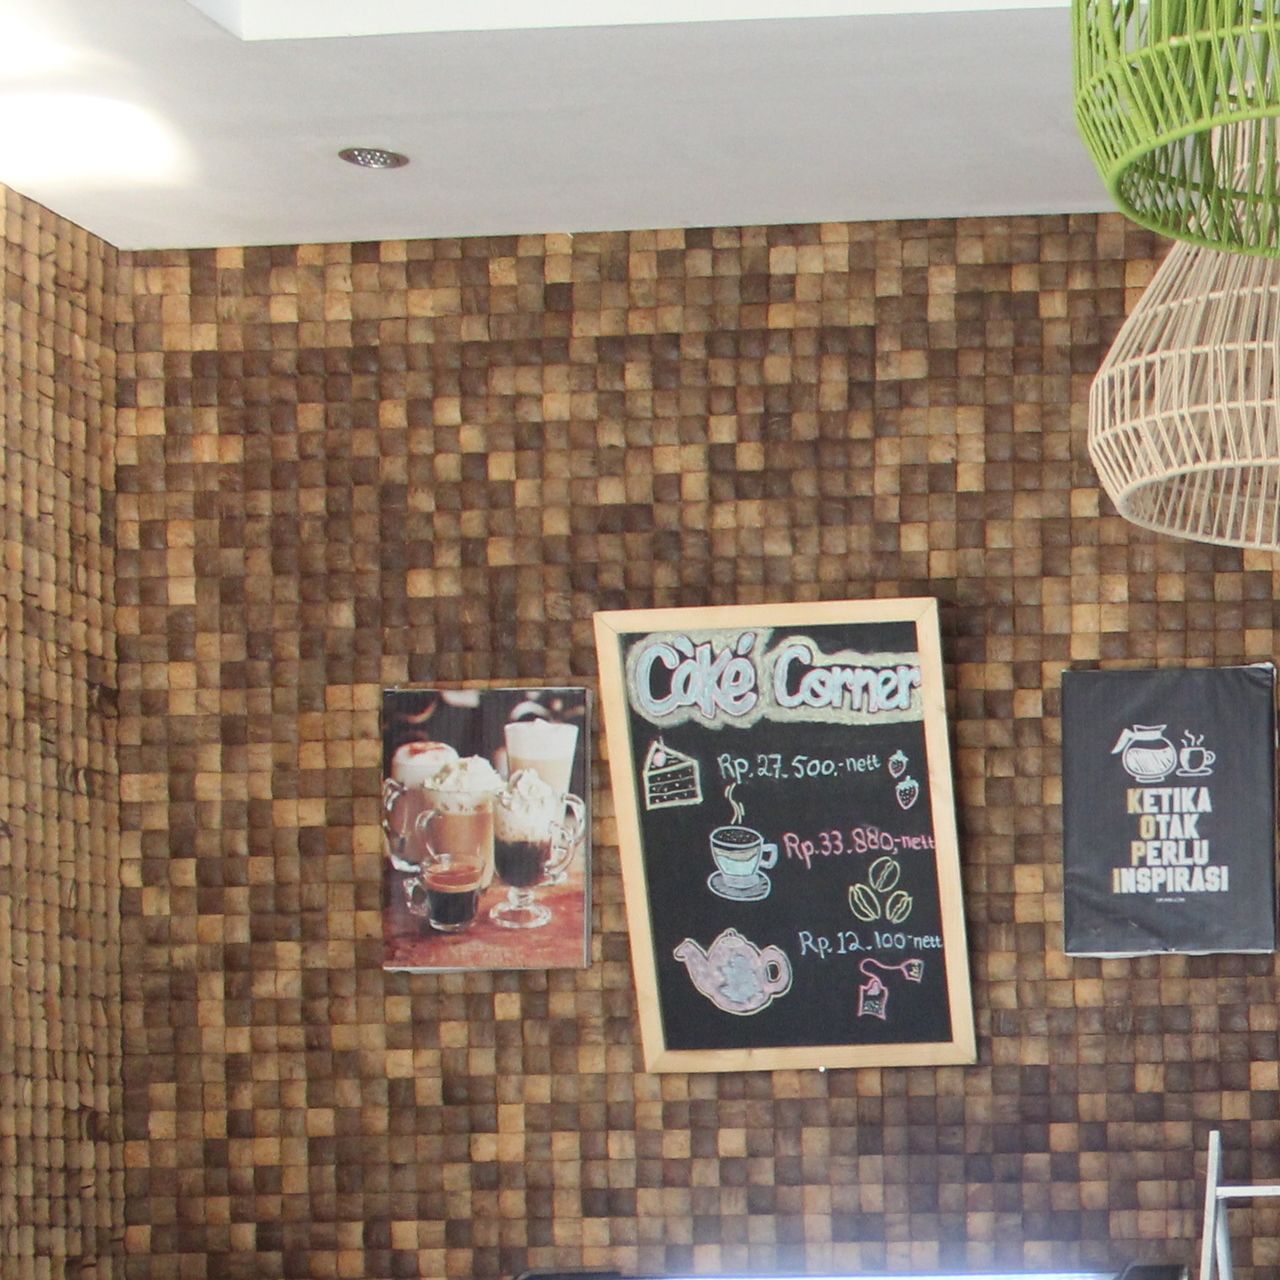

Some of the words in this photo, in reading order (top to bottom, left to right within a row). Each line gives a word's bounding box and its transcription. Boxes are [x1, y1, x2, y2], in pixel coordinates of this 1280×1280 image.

[774, 645, 921, 712] Corner
[1127, 787, 1212, 813] KETIKA
[1140, 815, 1198, 840] OTAK
[1132, 841, 1209, 866] PERLU
[1113, 866, 1229, 893] INSPIRASI
